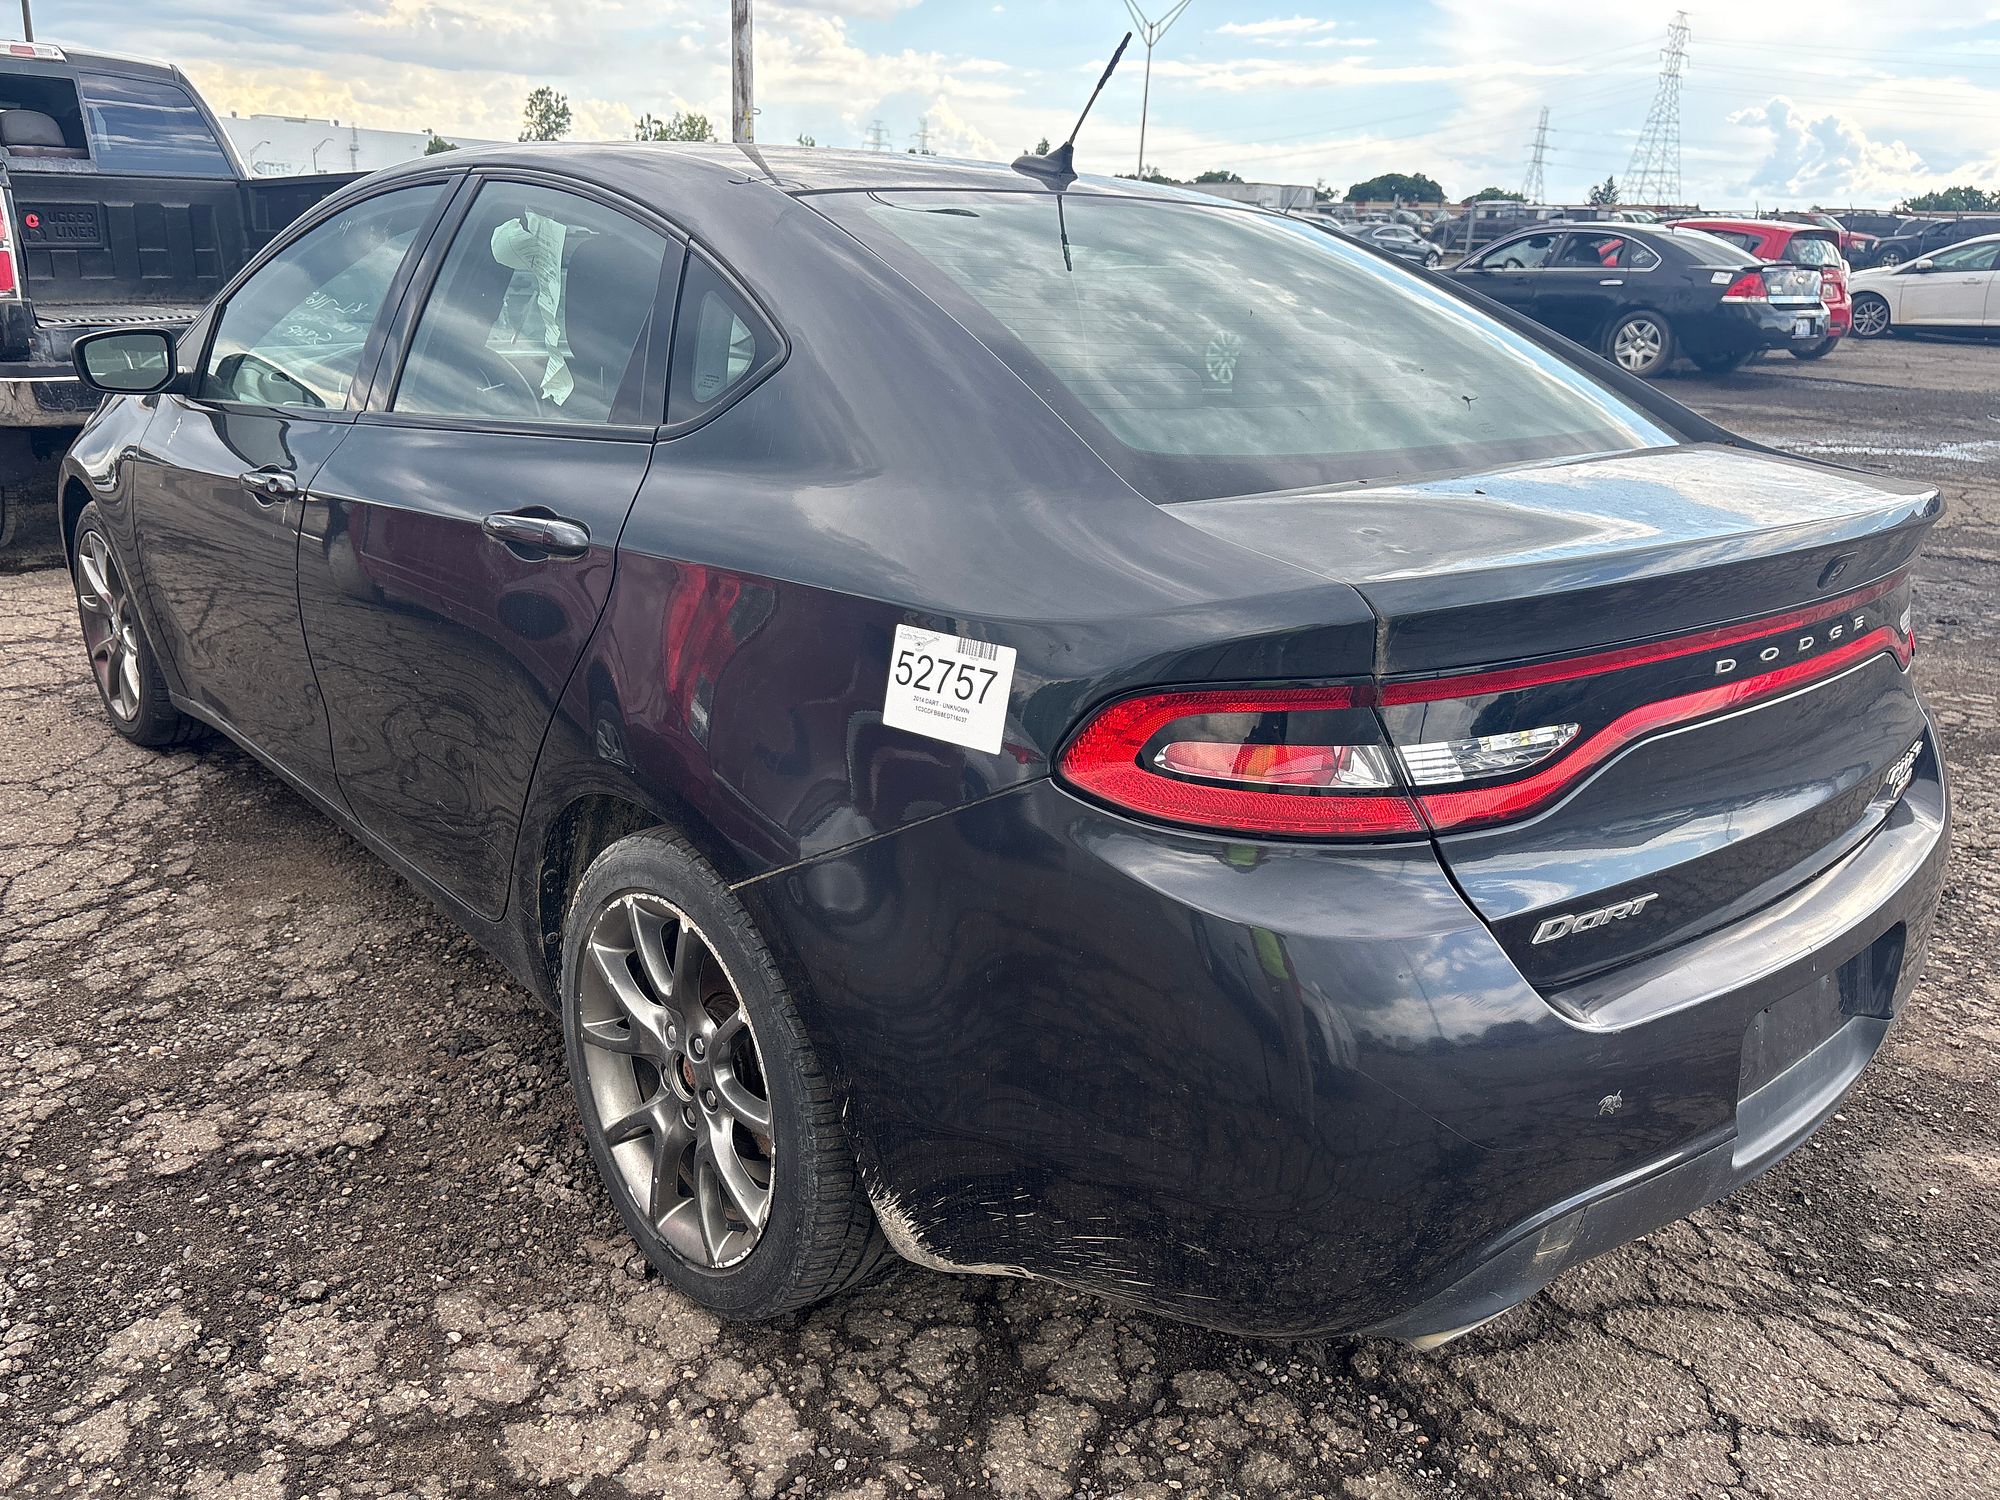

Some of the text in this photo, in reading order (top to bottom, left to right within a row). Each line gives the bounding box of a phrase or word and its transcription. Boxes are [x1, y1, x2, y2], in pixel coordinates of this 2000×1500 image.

[55, 226, 96, 239] LINER
[1715, 616, 1865, 675] DODGE
[895, 650, 998, 704] 52757
[925, 697, 939, 707] DART
[1530, 891, 1659, 945] DART
